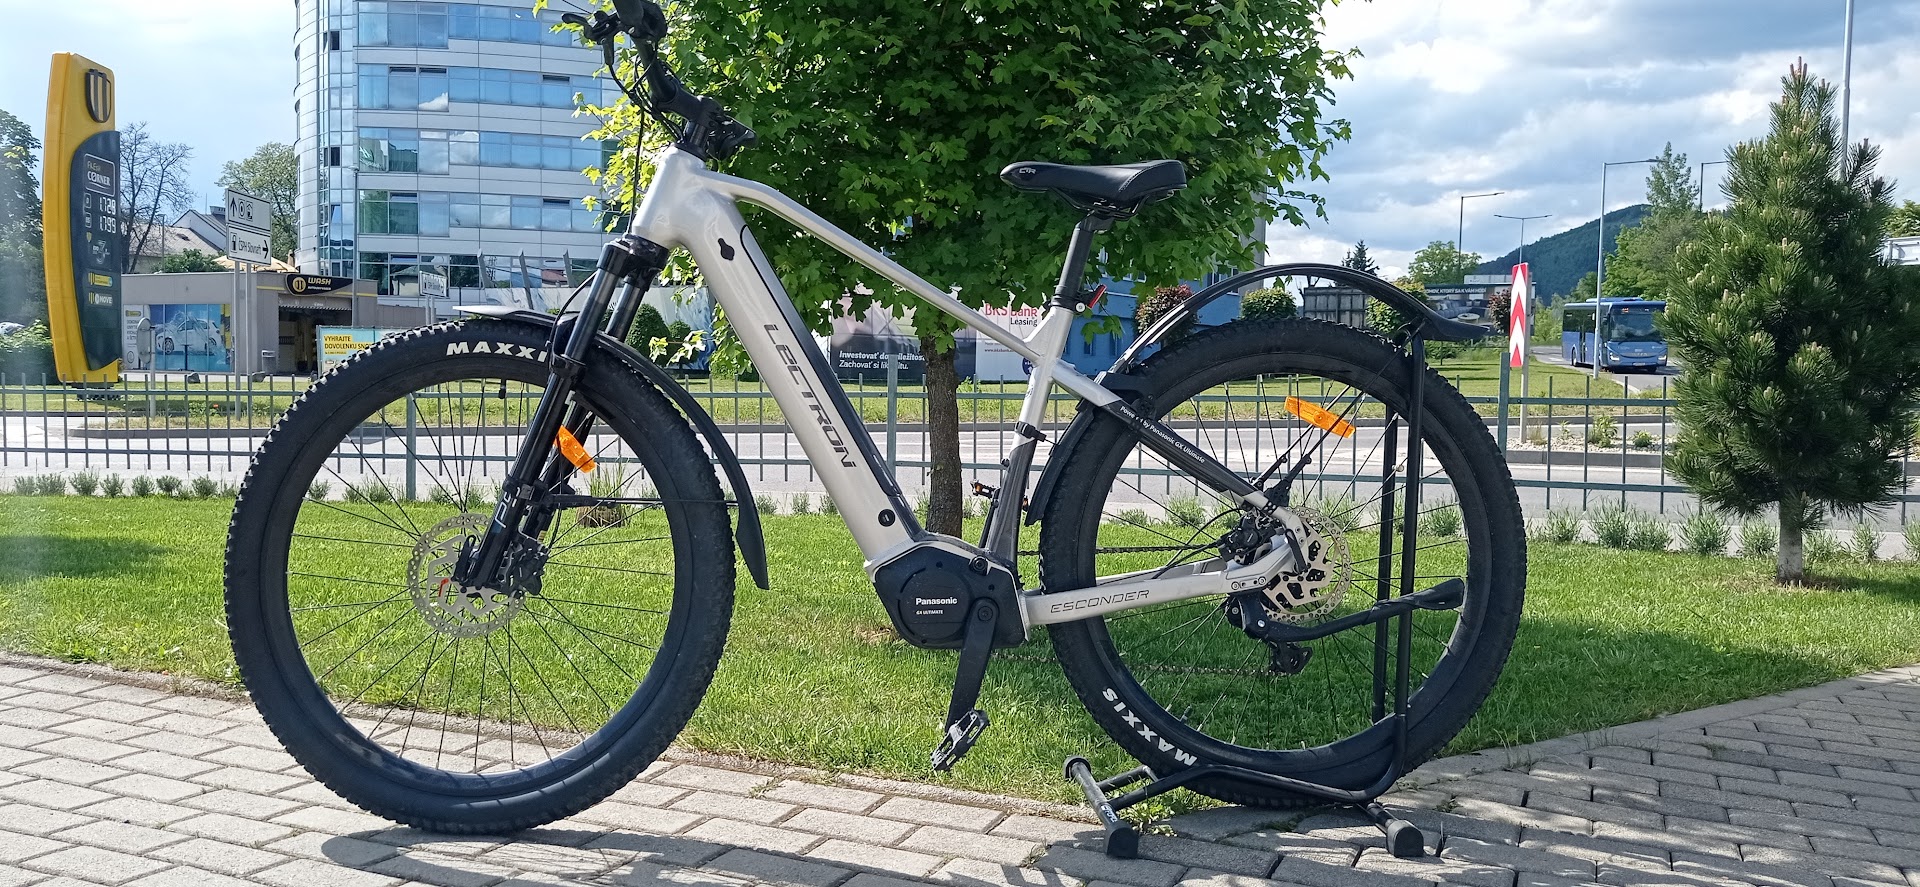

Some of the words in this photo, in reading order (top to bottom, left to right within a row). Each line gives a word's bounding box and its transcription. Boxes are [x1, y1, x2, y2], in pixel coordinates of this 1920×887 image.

[308, 277, 332, 285] WASH
[1010, 317, 1038, 327] Leasing
[840, 350, 879, 360] Investovať
[839, 360, 872, 368] Zachovať
[764, 324, 856, 468] LECTRON
[1142, 420, 1151, 429] by
[1150, 424, 1175, 444] Panasonic
[1174, 441, 1184, 450] GX
[1183, 446, 1205, 464] Ultimate
[916, 596, 958, 606] Panasonic
[1050, 590, 1150, 614] ESCONDER
[1102, 688, 1198, 766] MAXXIS
